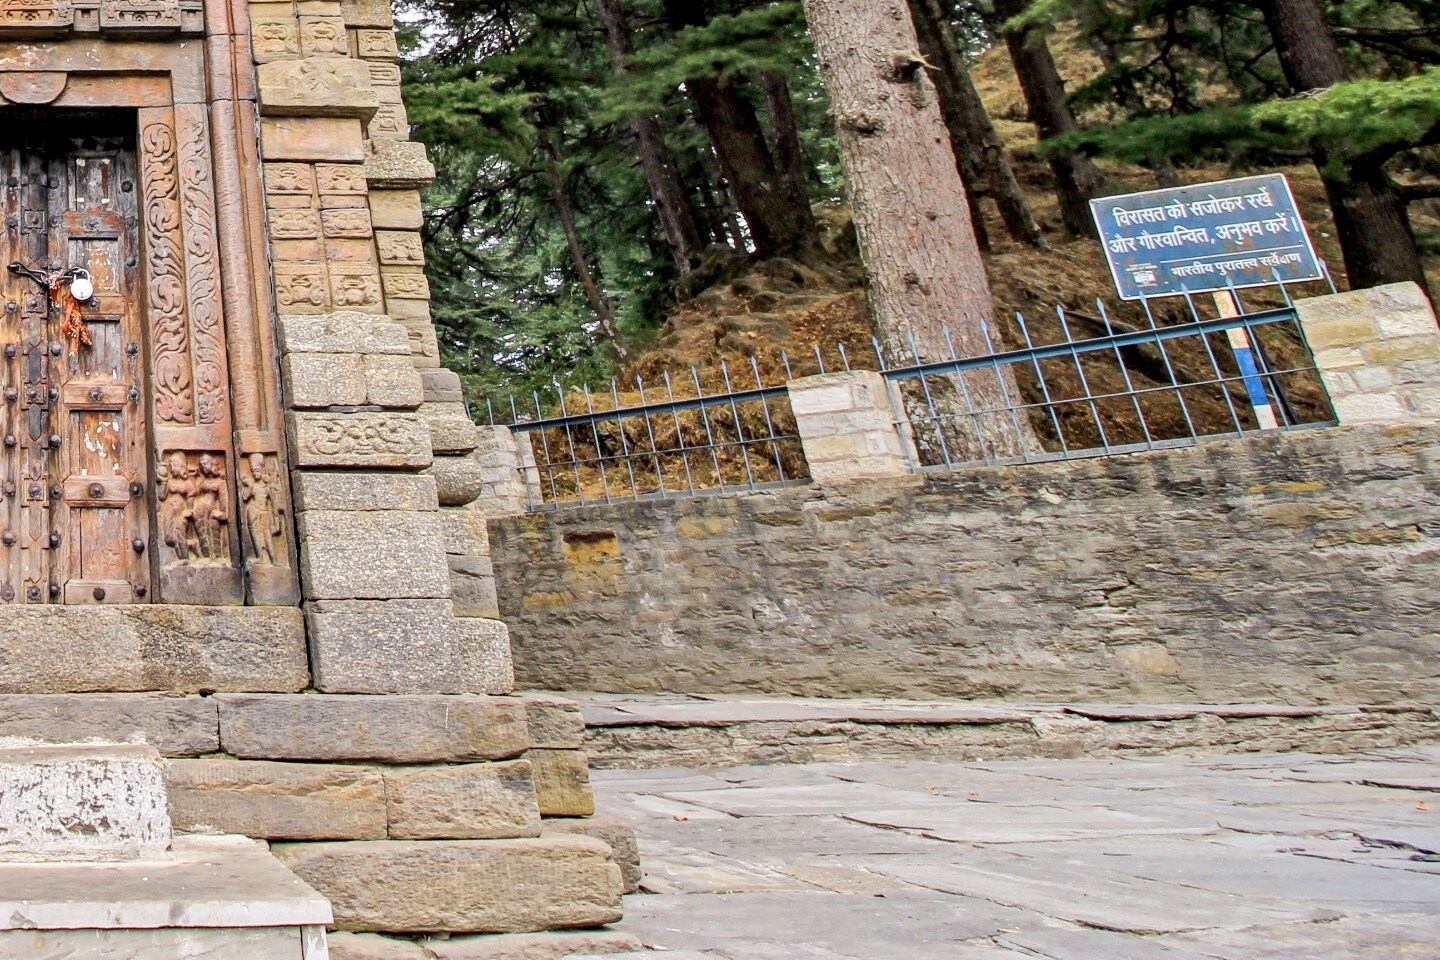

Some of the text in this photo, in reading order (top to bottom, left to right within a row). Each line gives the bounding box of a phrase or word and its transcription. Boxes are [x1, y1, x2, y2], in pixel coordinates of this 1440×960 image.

[1112, 206, 1166, 227] विरासत
[1165, 198, 1188, 219] को
[1244, 186, 1273, 209] रखें
[1109, 232, 1138, 254] और
[1215, 220, 1263, 245] अनुभव
[1171, 261, 1214, 278] भारतीय
